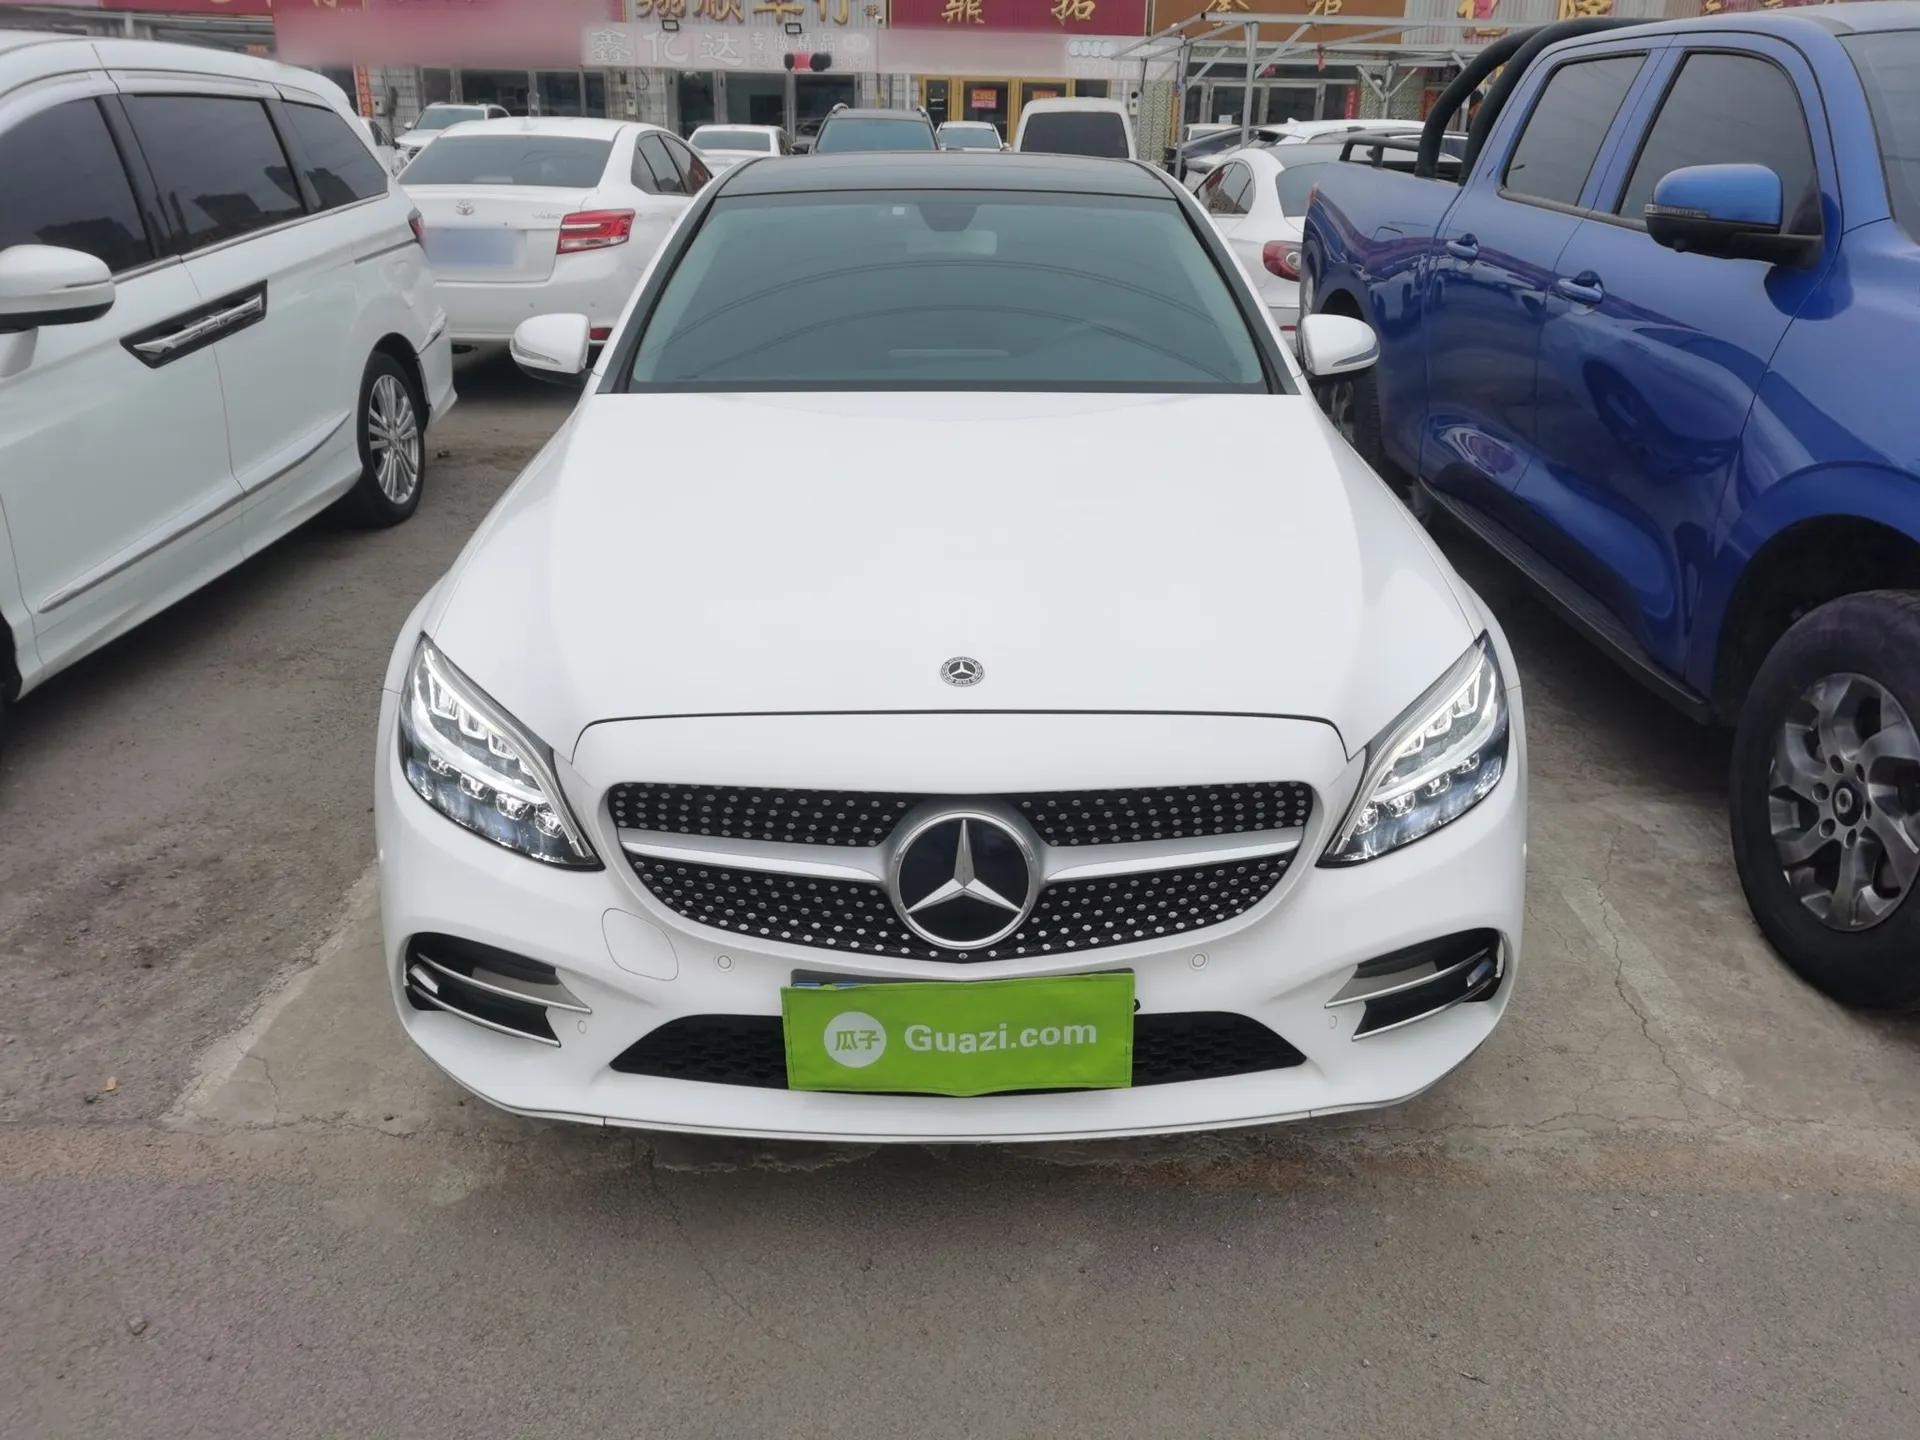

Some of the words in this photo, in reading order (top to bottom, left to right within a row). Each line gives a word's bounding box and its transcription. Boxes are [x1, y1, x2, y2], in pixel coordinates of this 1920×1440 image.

[590, 28, 745, 66] 鑫亿达
[834, 1029, 881, 1052] 瓜子
[904, 1023, 1097, 1054] Guazi.com
